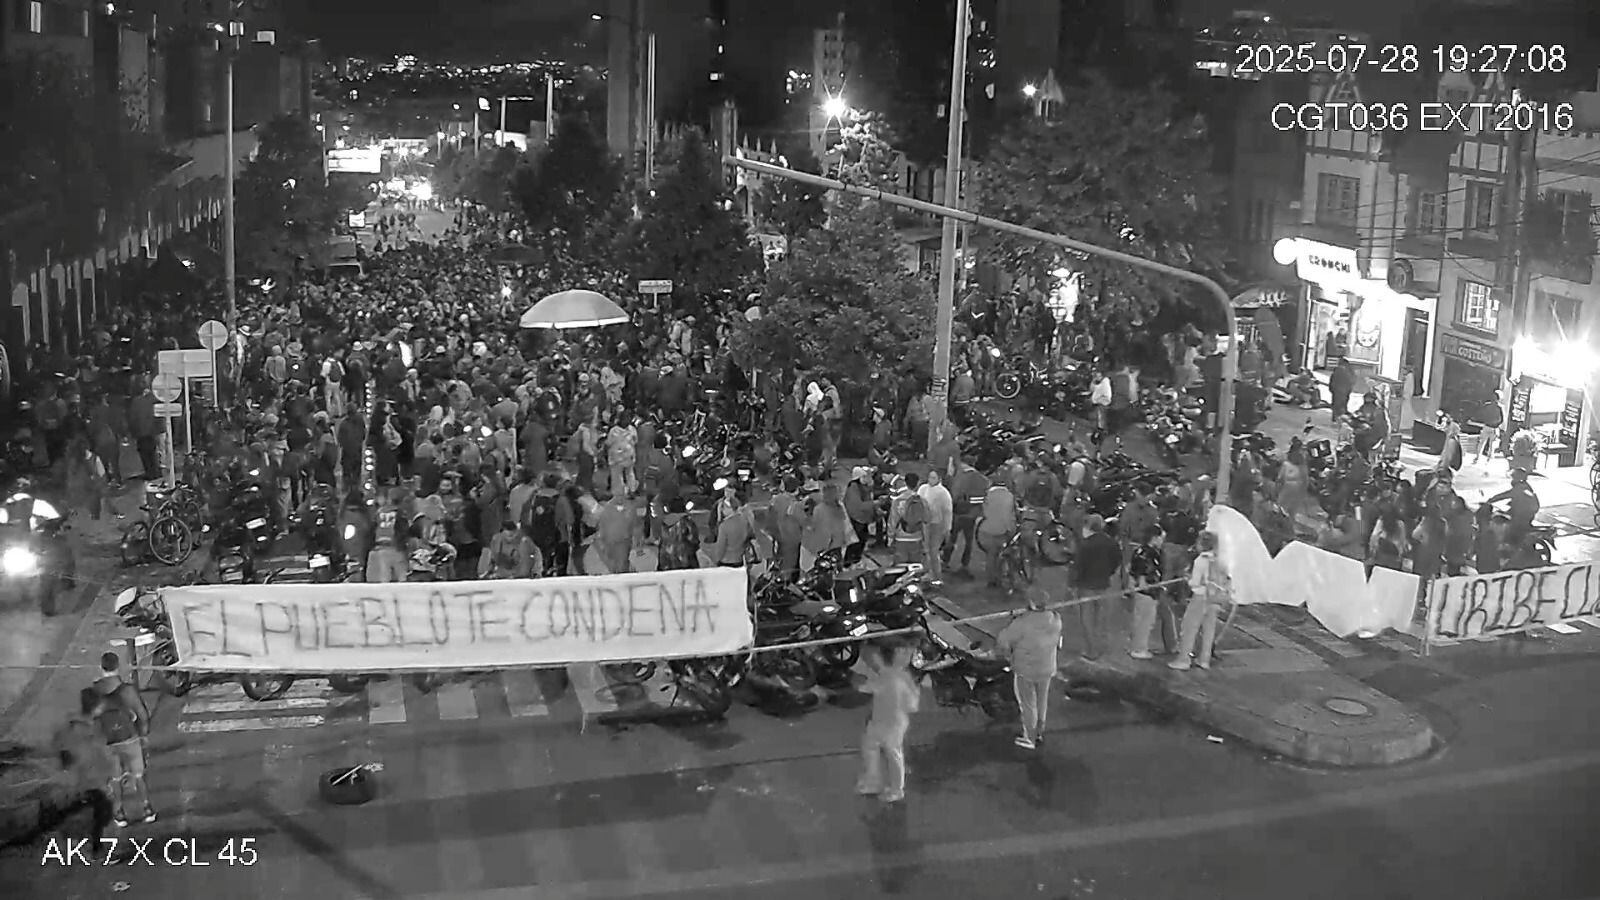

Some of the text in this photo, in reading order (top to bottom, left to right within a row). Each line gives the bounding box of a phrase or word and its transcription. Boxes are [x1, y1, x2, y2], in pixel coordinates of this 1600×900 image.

[183, 579, 719, 656] EL PUEBLO TE CONDENA
[1436, 570, 1557, 637] URIBE
